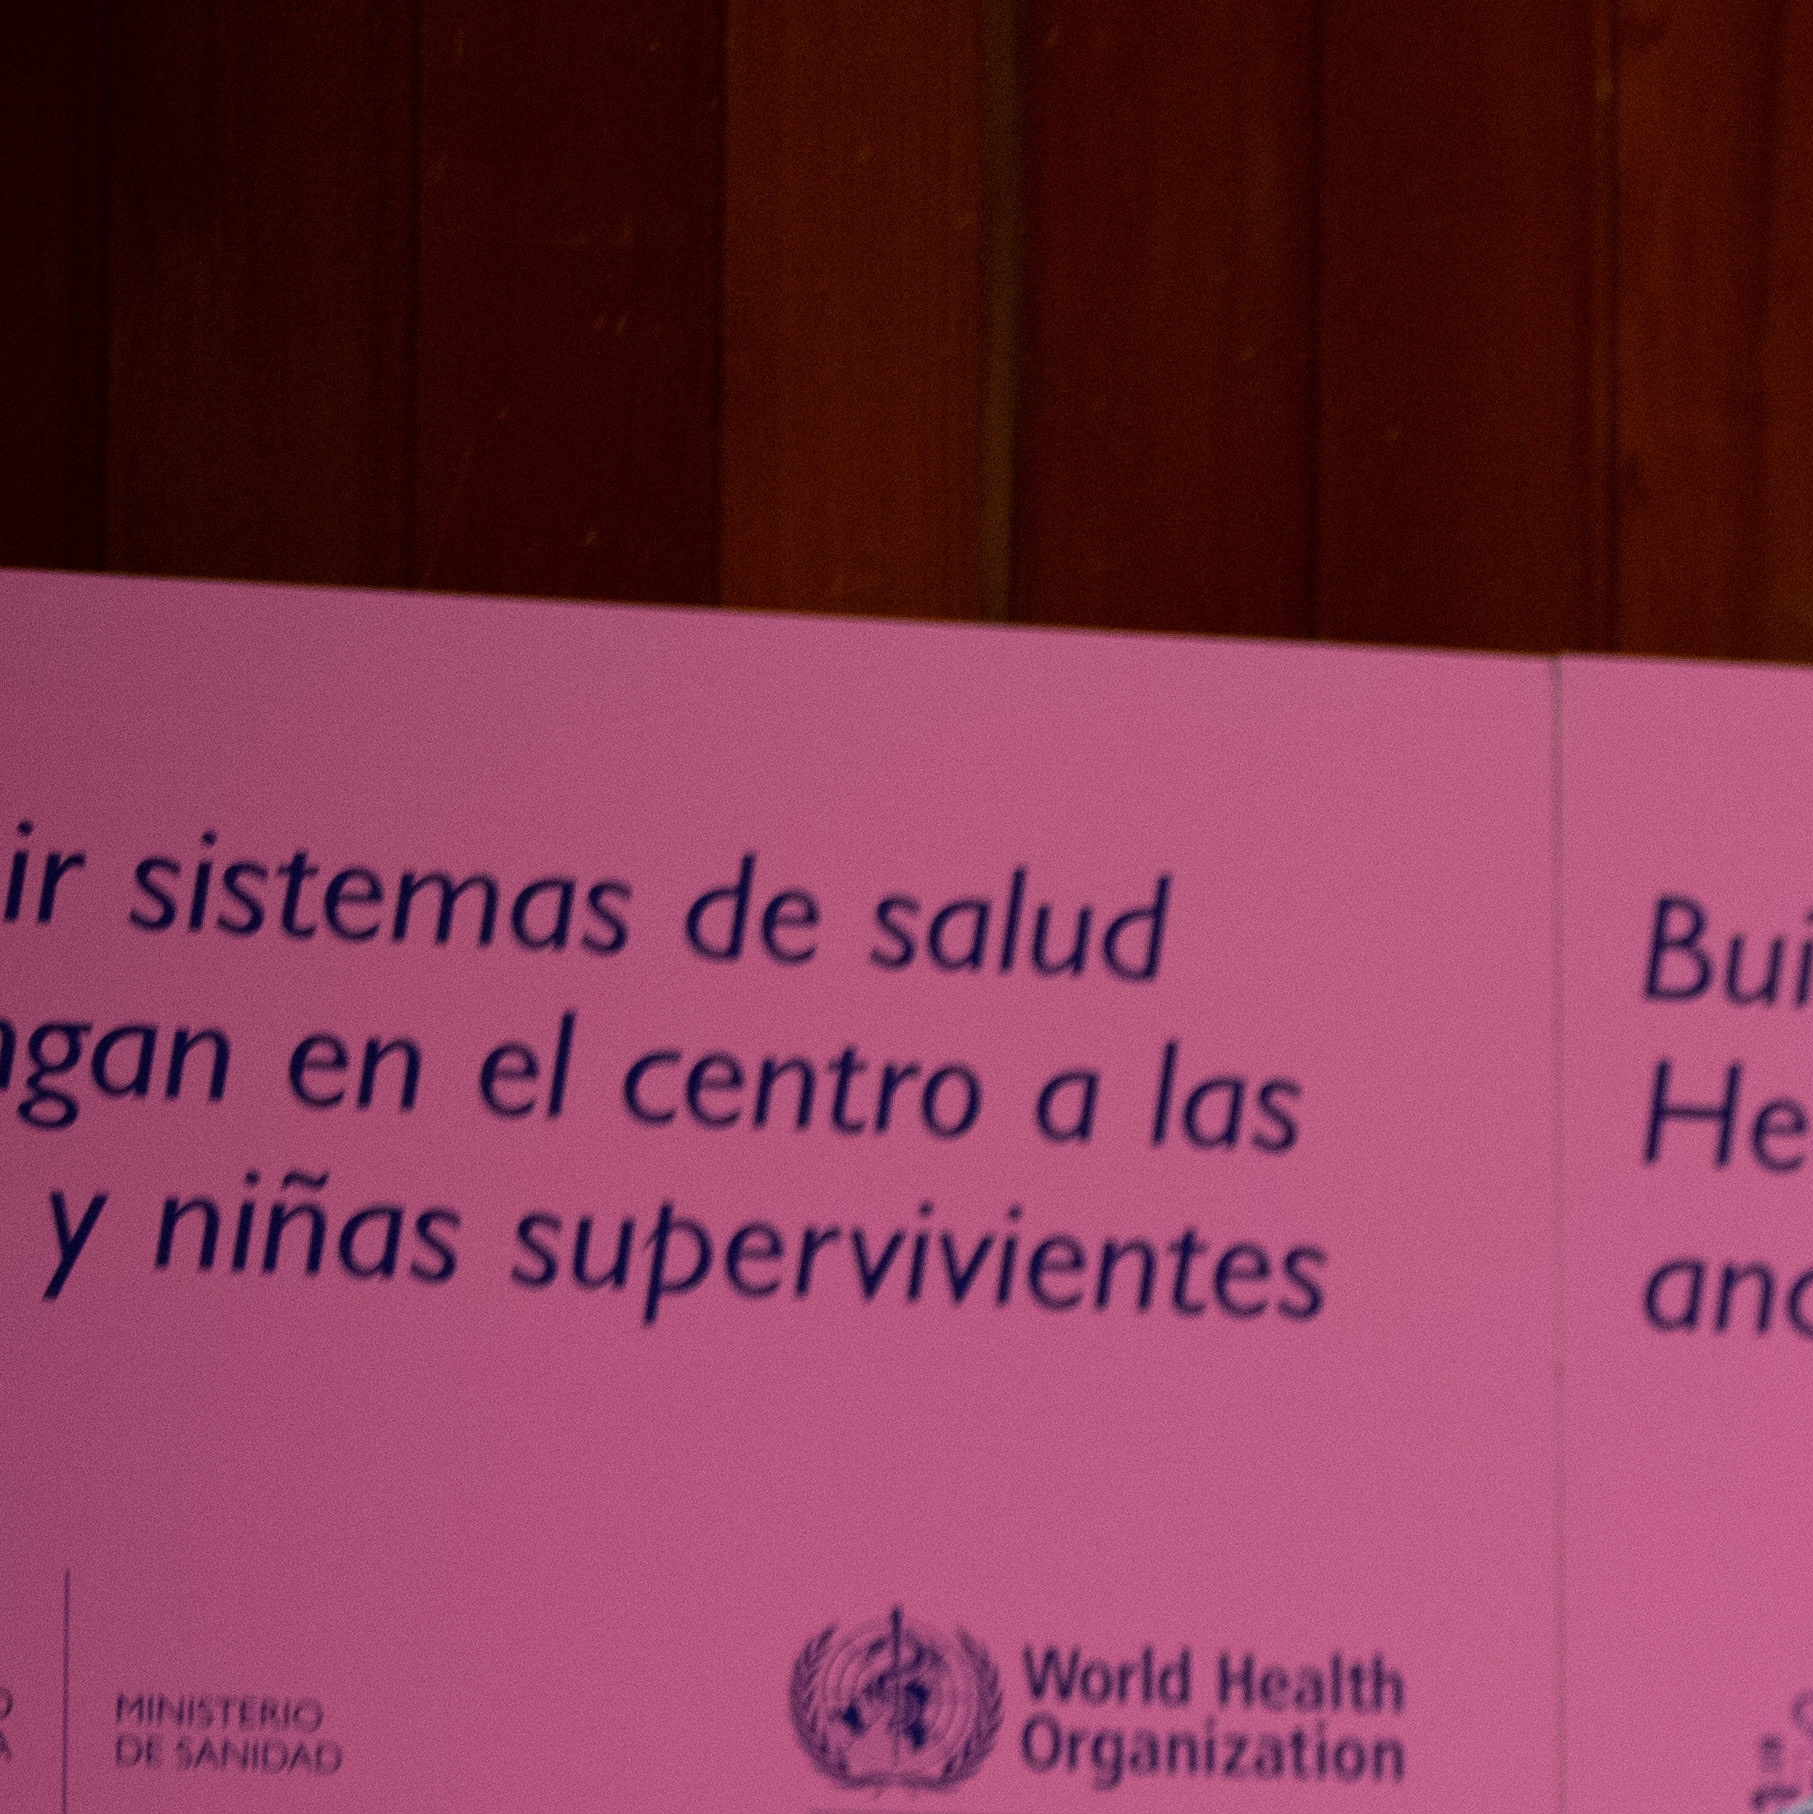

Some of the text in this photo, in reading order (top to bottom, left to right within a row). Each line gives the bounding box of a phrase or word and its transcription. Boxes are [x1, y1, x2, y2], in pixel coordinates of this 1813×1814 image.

[1, 819, 1173, 984] ir sistemas de salud
[0, 1008, 1302, 1156] gan en el centro a las
[42, 1168, 1326, 1329] y niñas supervivientes
[114, 1691, 325, 1734] MINISTERIO
[1020, 1644, 1407, 1715] World Health
[113, 1733, 345, 1775] DE SANIDAD
[1018, 1711, 1408, 1792] Organization
